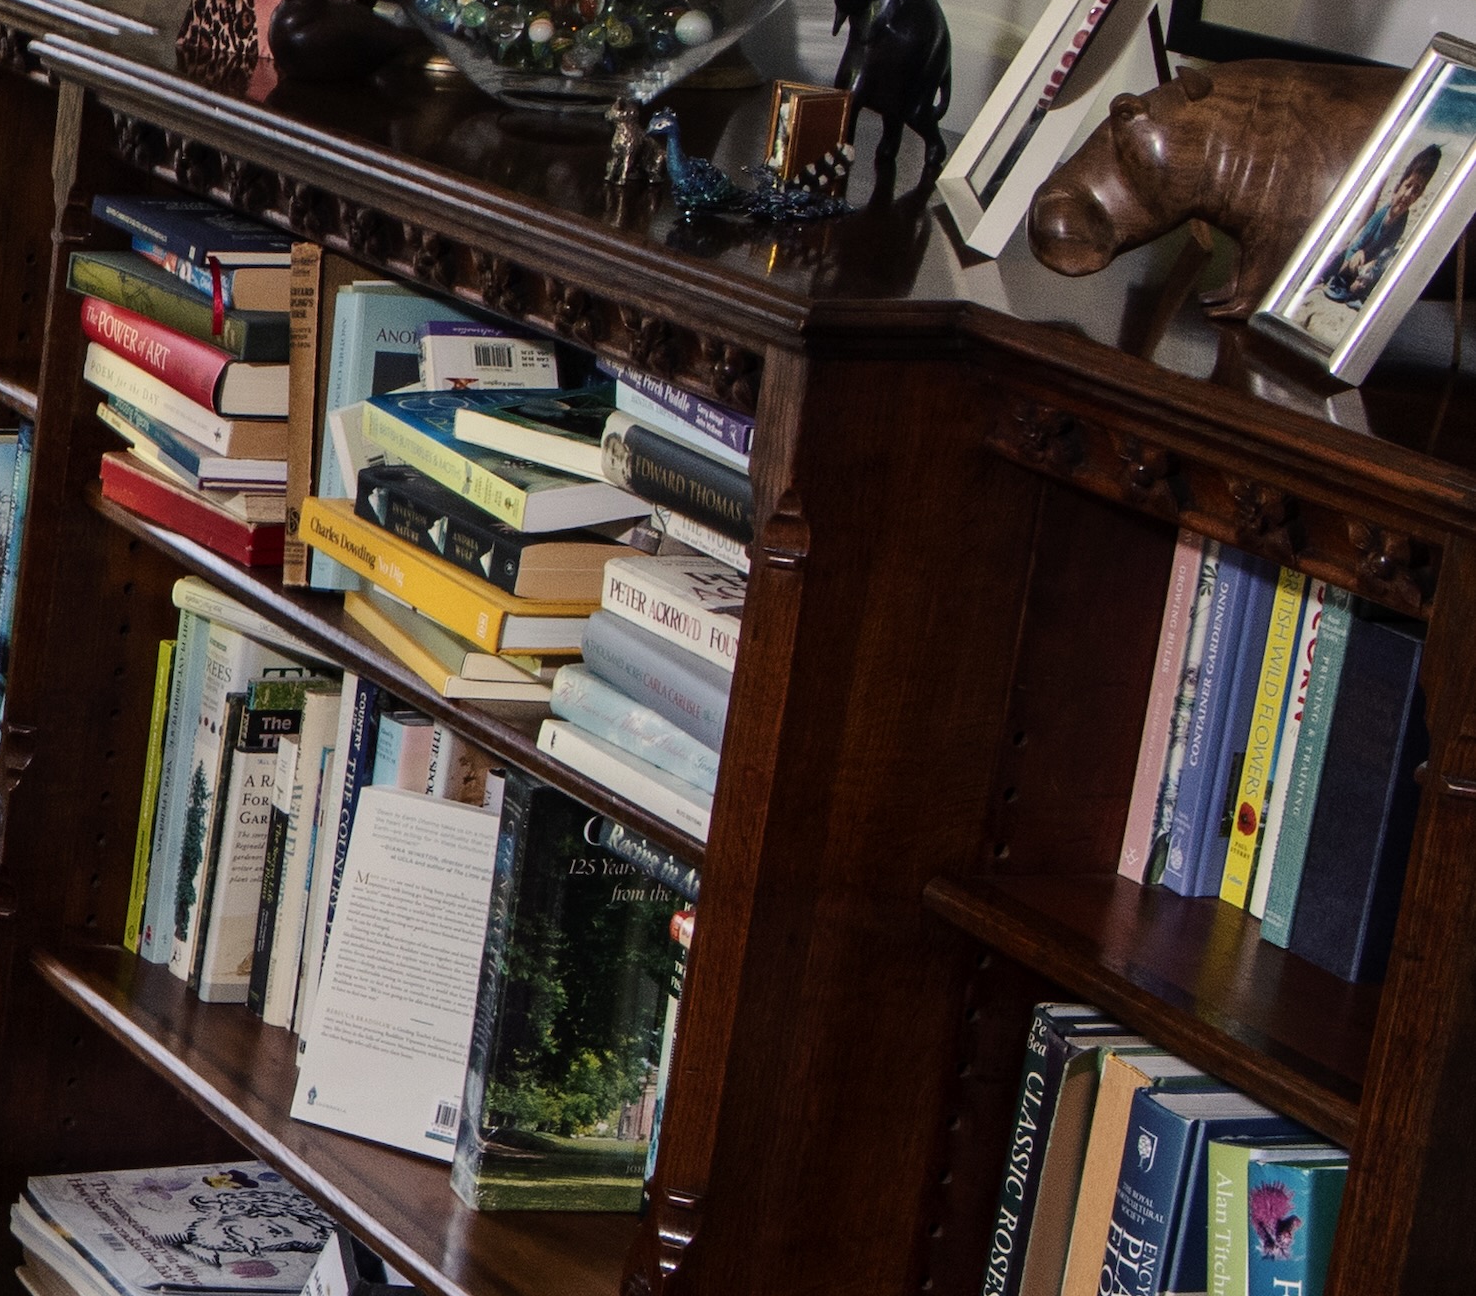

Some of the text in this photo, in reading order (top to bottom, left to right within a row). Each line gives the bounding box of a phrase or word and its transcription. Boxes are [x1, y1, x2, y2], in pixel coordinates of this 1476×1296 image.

[97, 311, 172, 372] POWER ART
[337, 317, 348, 367] ANOTHER
[375, 327, 421, 345] ANOT
[634, 456, 743, 521] EDWARD THOMAS
[309, 516, 340, 546] Charles
[339, 534, 376, 569] Dowding
[609, 577, 703, 642] PETER ACKROYD
[1158, 564, 1189, 674] GROWING BULBS
[205, 658, 233, 683] REES
[1188, 581, 1230, 767] CONTAINER GARDENING
[1244, 567, 1302, 799] BRITISH WILD FLOWERS
[1308, 655, 1331, 725] PRUNING
[261, 716, 292, 731] The
[343, 691, 368, 805] COUNTRY THE
[1307, 727, 1317, 737] &
[242, 793, 270, 807] FOR
[244, 775, 256, 788] A
[1292, 743, 1314, 817] TRAINING
[265, 822, 282, 904] The Secret Life
[568, 857, 637, 877] 125 Years
[607, 822, 680, 882] Racing in
[260, 867, 271, 900] Plants
[610, 882, 672, 905] from the
[1005, 1069, 1046, 1202] CLASSIC
[1132, 1186, 1154, 1208] ROYAL
[1216, 1169, 1236, 1225] Alan
